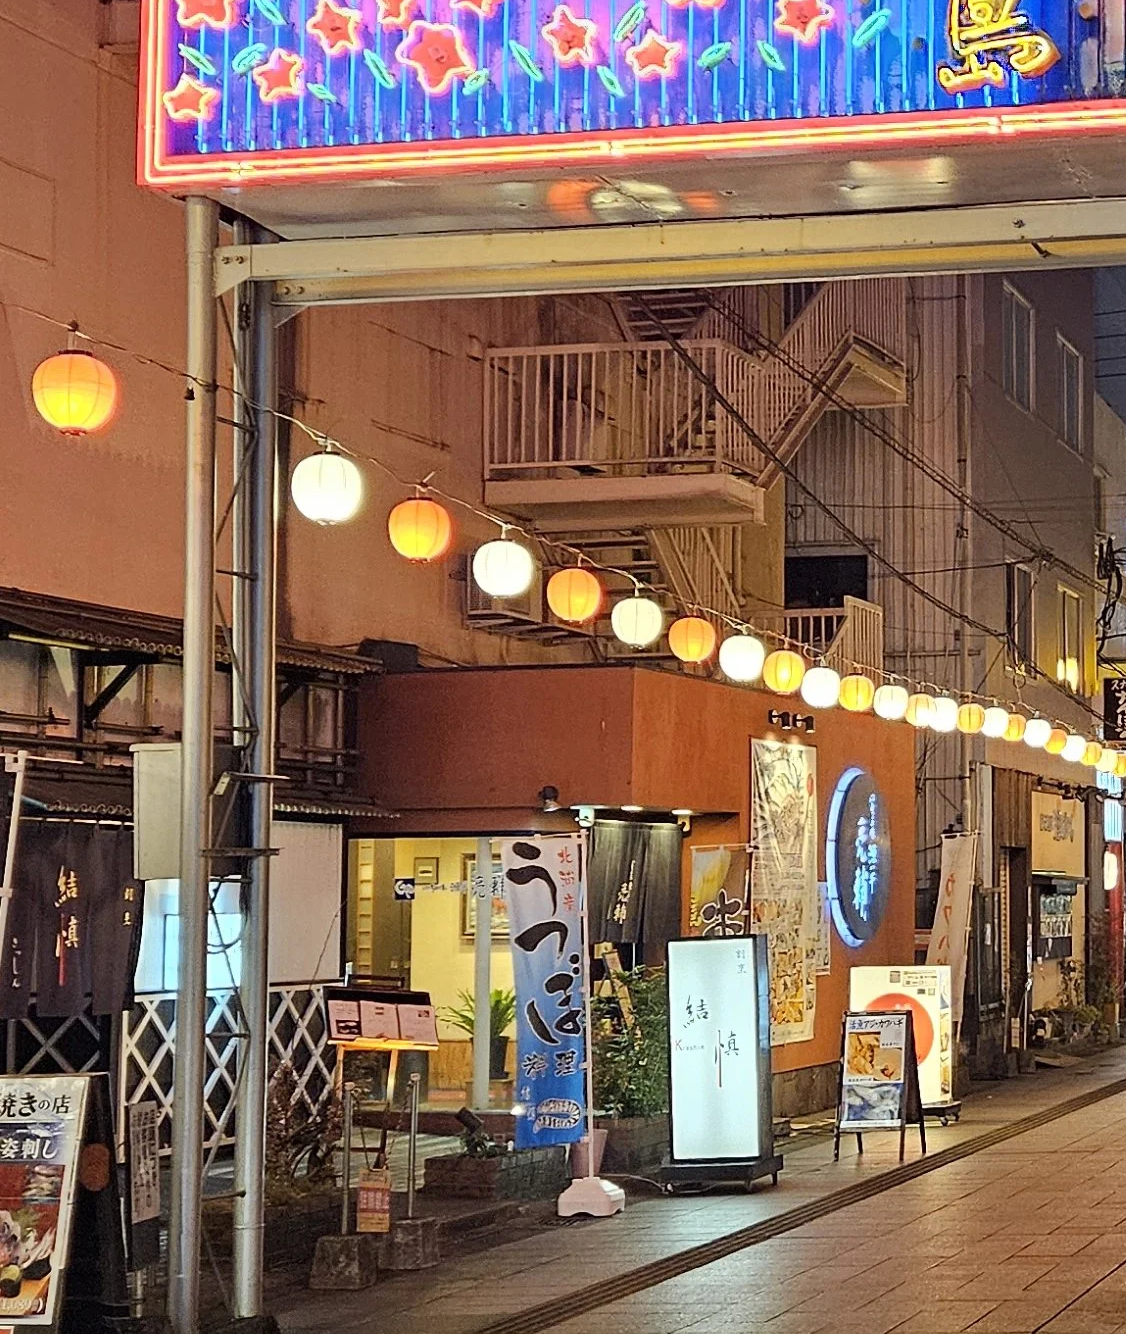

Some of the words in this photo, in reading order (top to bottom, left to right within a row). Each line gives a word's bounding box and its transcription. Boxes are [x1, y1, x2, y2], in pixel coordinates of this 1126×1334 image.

[506, 841, 583, 1045] うつぼ
[521, 1048, 579, 1081] 料理
[682, 994, 740, 1089] 結慎
[0, 1137, 58, 1160] 姿刺し
